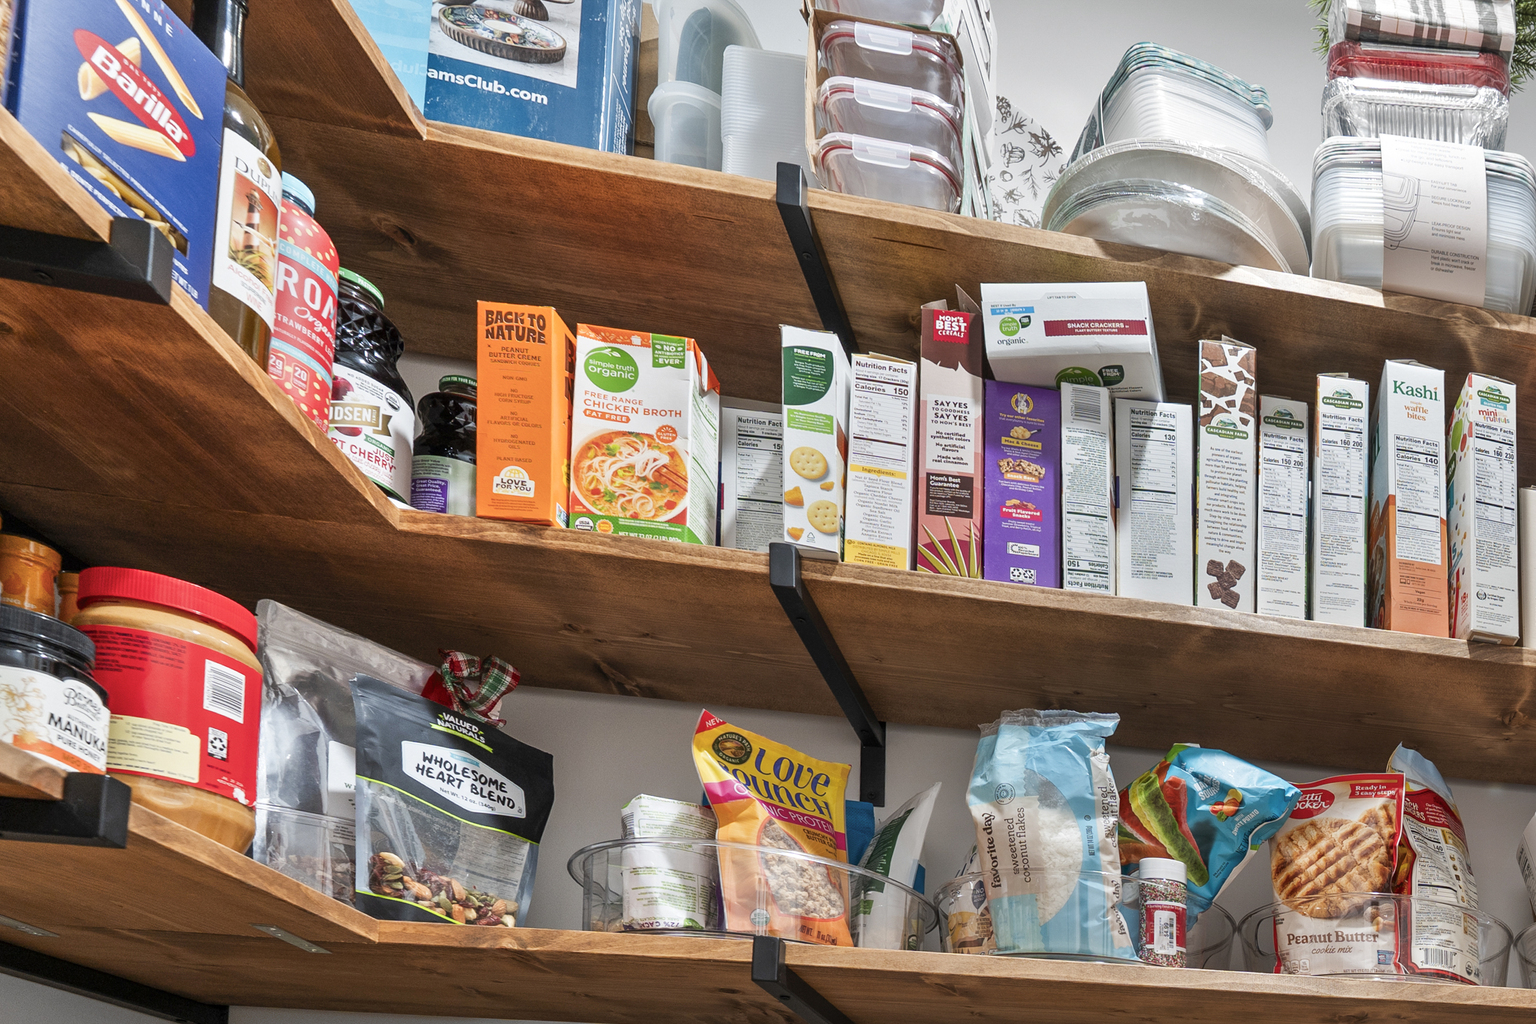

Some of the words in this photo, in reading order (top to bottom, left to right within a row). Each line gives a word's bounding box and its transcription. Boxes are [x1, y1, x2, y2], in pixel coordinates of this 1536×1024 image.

[91, 45, 184, 143] Barilla
[485, 310, 525, 327] BACK
[528, 314, 546, 331] TO
[935, 320, 966, 331] BEST
[485, 325, 547, 345] NATURE
[588, 358, 614, 372] simple
[615, 363, 635, 372] truth
[588, 365, 635, 380] organic
[855, 383, 885, 393] Calories
[893, 387, 909, 396] 150
[1393, 380, 1438, 401] Kashi
[584, 390, 608, 400] FREE
[611, 395, 644, 406] RANGE
[952, 401, 968, 409] YES
[583, 399, 639, 414] CHICKEN
[643, 407, 682, 418] BROTH
[586, 410, 603, 418] FAT
[605, 413, 628, 423] FREE
[1404, 404, 1428, 414] waffle
[1407, 412, 1426, 421] bites
[952, 414, 968, 422] YES
[1396, 454, 1421, 462] Calories
[1424, 457, 1438, 465] 140
[501, 478, 527, 486] LOVE
[442, 712, 479, 732] VALUED
[48, 712, 105, 752] MANUKA
[437, 719, 485, 743] NATURALS
[57, 734, 76, 750] PURE
[79, 747, 100, 761] HONEY
[423, 752, 508, 793] WHOLESOME
[416, 763, 464, 789] HEART
[470, 784, 515, 809] BLEND
[1355, 784, 1377, 792] Ready
[1016, 807, 1025, 841] flakes
[1004, 817, 1019, 875] sweetened
[1021, 844, 1031, 883] coconut
[1287, 932, 1332, 946] Peanut
[1334, 930, 1379, 943] Butter
[1312, 945, 1336, 954] cookie
[1337, 945, 1352, 953] mix
